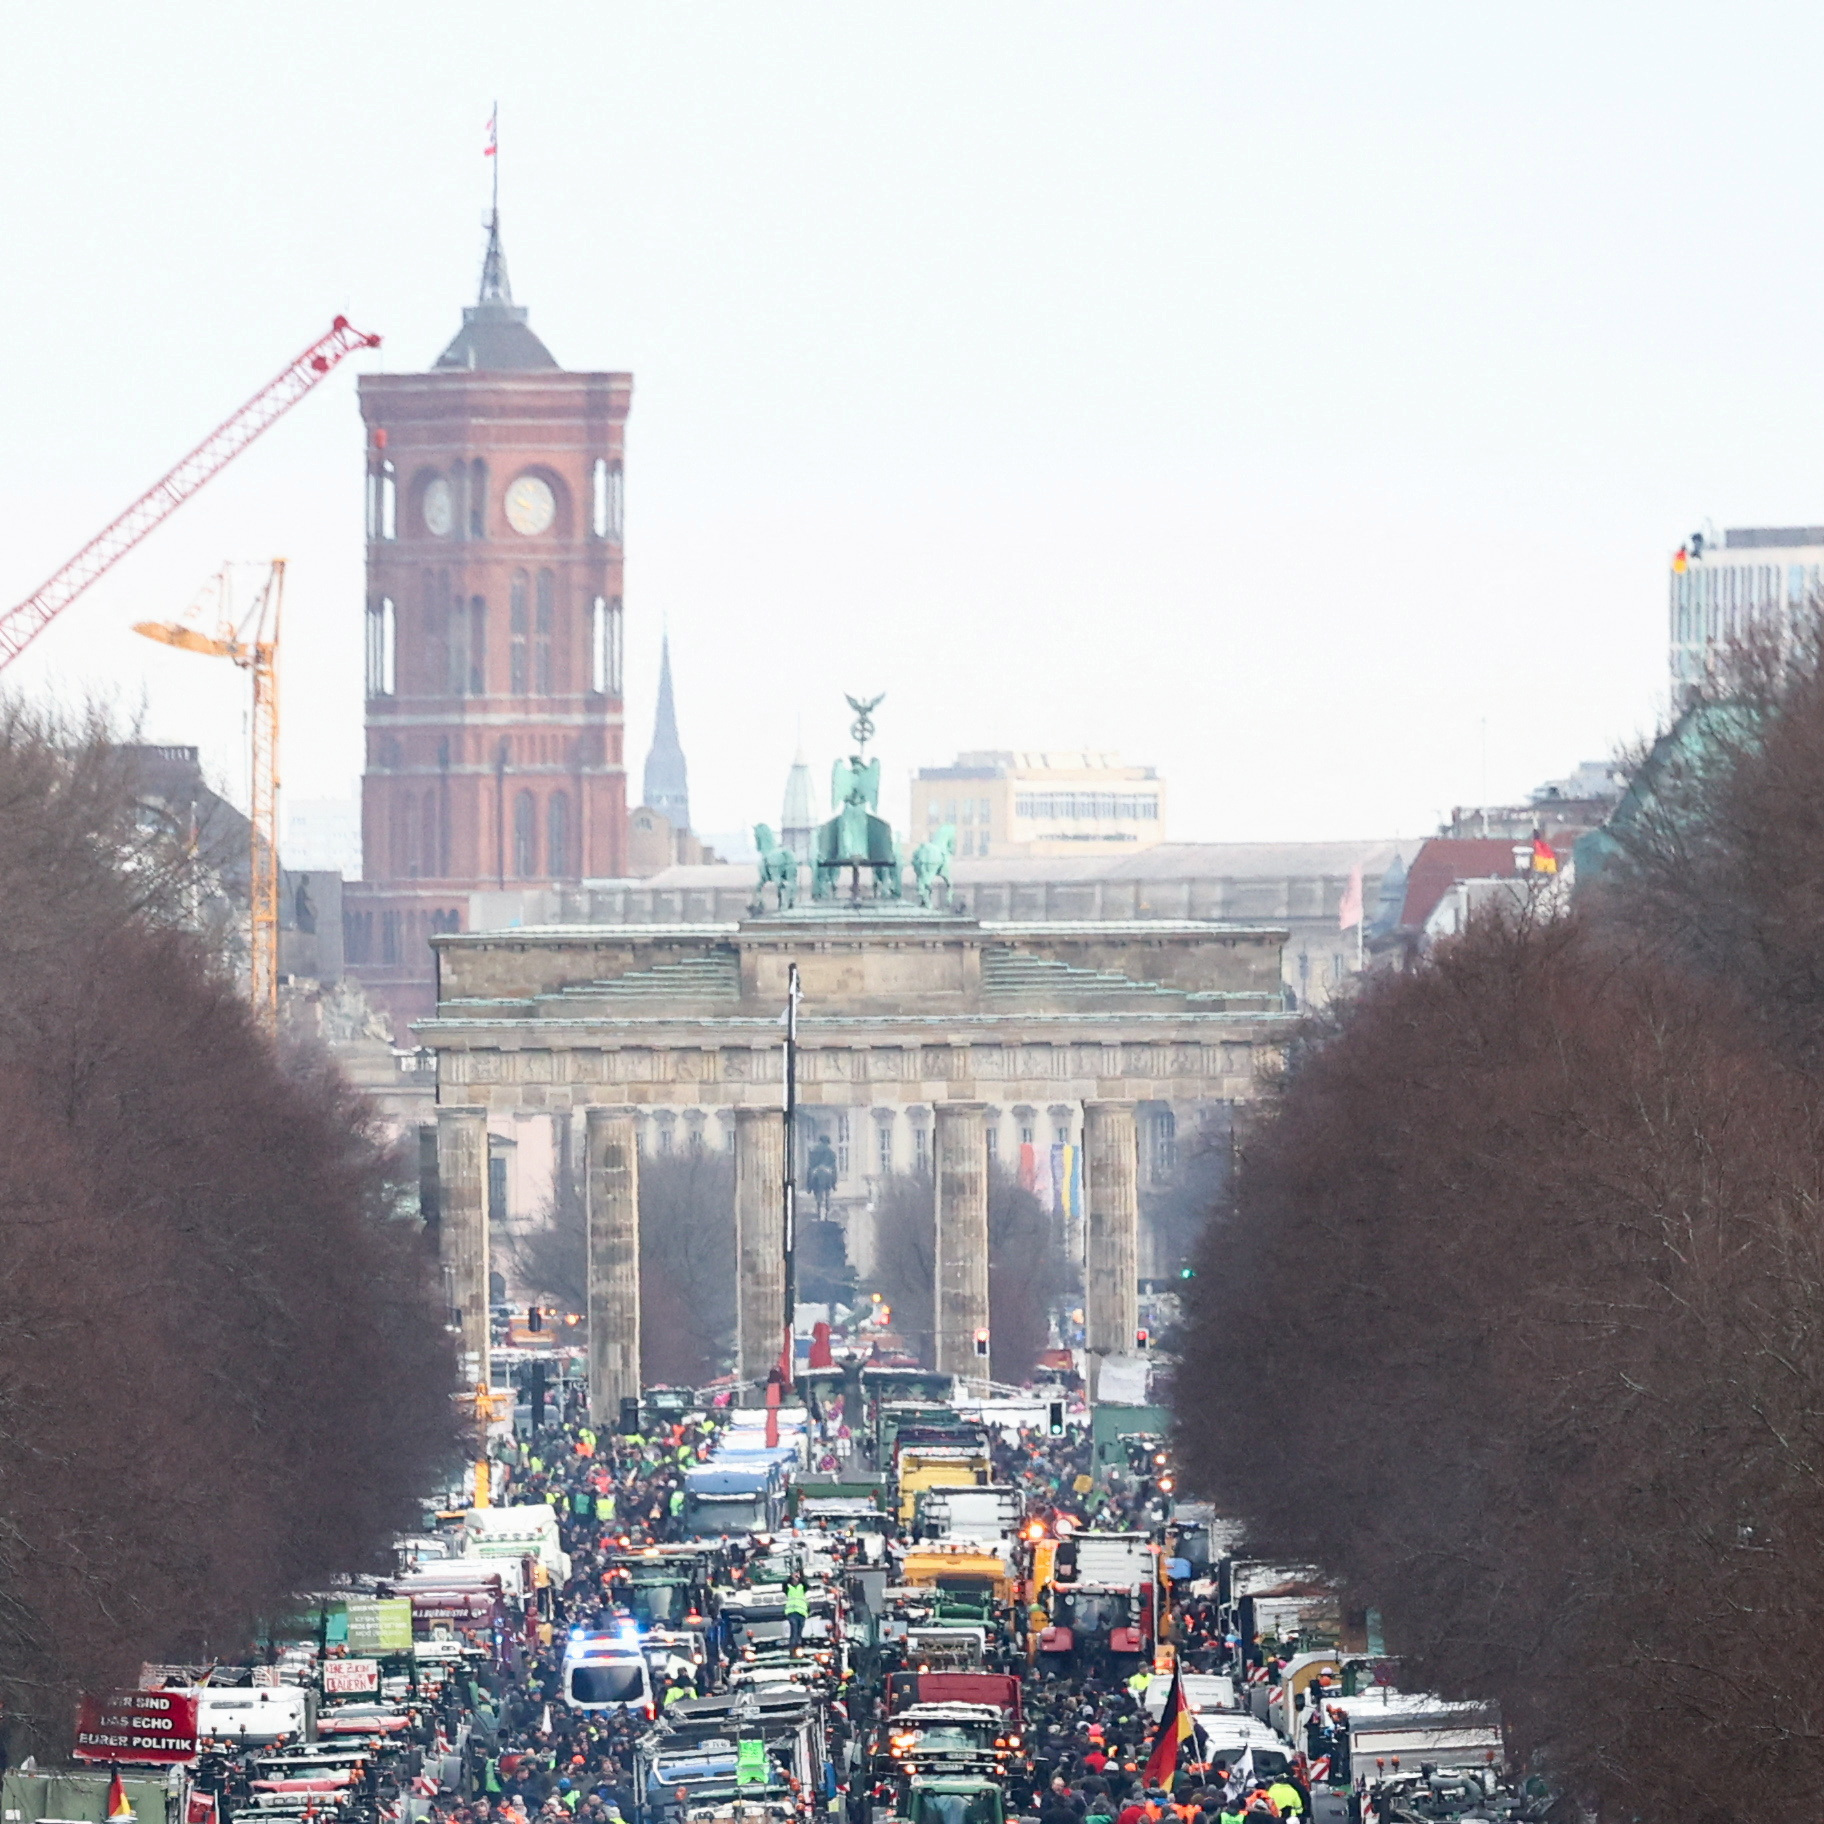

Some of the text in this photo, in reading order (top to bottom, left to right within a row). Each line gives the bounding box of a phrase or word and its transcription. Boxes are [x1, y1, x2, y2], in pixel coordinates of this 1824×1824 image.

[136, 1697, 171, 1710] SIND
[132, 1717, 173, 1730] ECHO
[79, 1733, 192, 1750] EURER POLITIK
